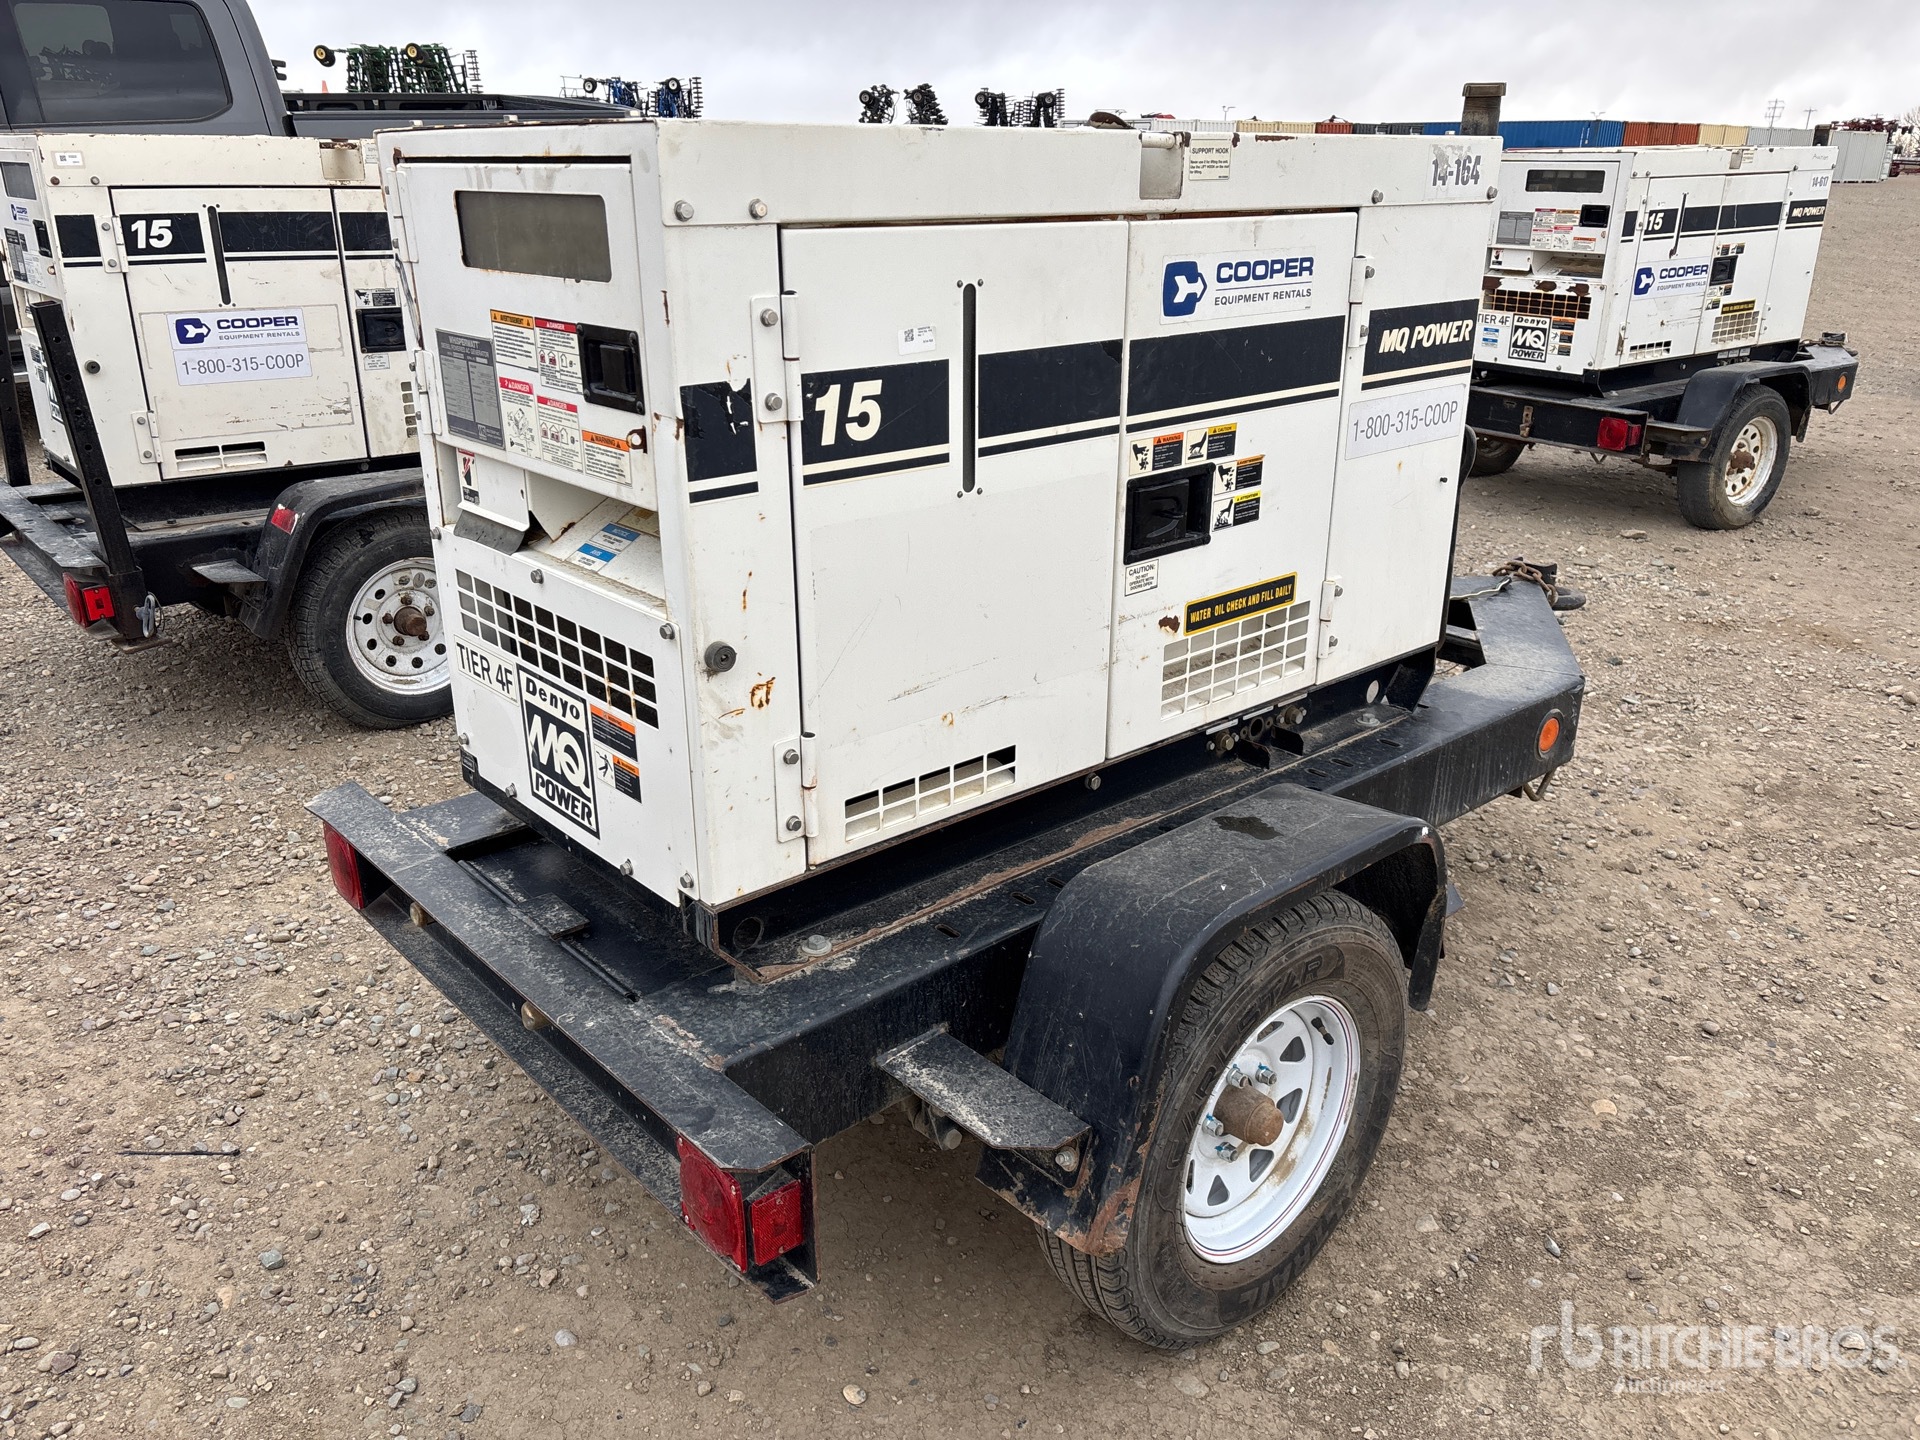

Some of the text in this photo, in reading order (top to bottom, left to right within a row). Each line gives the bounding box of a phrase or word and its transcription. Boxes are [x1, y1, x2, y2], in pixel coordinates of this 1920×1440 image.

[1432, 155, 1481, 186] 14-164
[1792, 206, 1826, 217] MQ POWER
[1648, 213, 1664, 231] 15
[131, 219, 173, 248] 15
[1216, 256, 1314, 284] COOPER
[1660, 264, 1709, 279] COOPER
[1657, 283, 1684, 291] EQUIPMENT
[1214, 288, 1312, 306] EQUIPMENT RENTALS
[217, 316, 298, 329] COOPER
[550, 322, 565, 330] DANGER
[1478, 314, 1510, 326] TIER 4F
[1516, 317, 1547, 326] Denyo
[219, 333, 264, 341] EQUIPMENT
[1379, 327, 1410, 354] MQ
[1410, 319, 1474, 349] POWER
[1511, 328, 1545, 350] MQ
[1511, 350, 1544, 360] POWER
[182, 354, 304, 375] 1-800-315-COOP
[511, 381, 530, 392] DANGER
[550, 400, 567, 409] DANGER
[815, 379, 882, 446] 15
[1353, 400, 1458, 441] 1-800-315-COOP
[1128, 564, 1156, 576] CAUTION:
[1190, 584, 1293, 623] WATER OIL CHECK AND FILL DAILY
[456, 642, 513, 694] TIER 4F
[525, 676, 581, 720] Denyo
[529, 714, 591, 801] MQ
[535, 772, 593, 827] POWER
